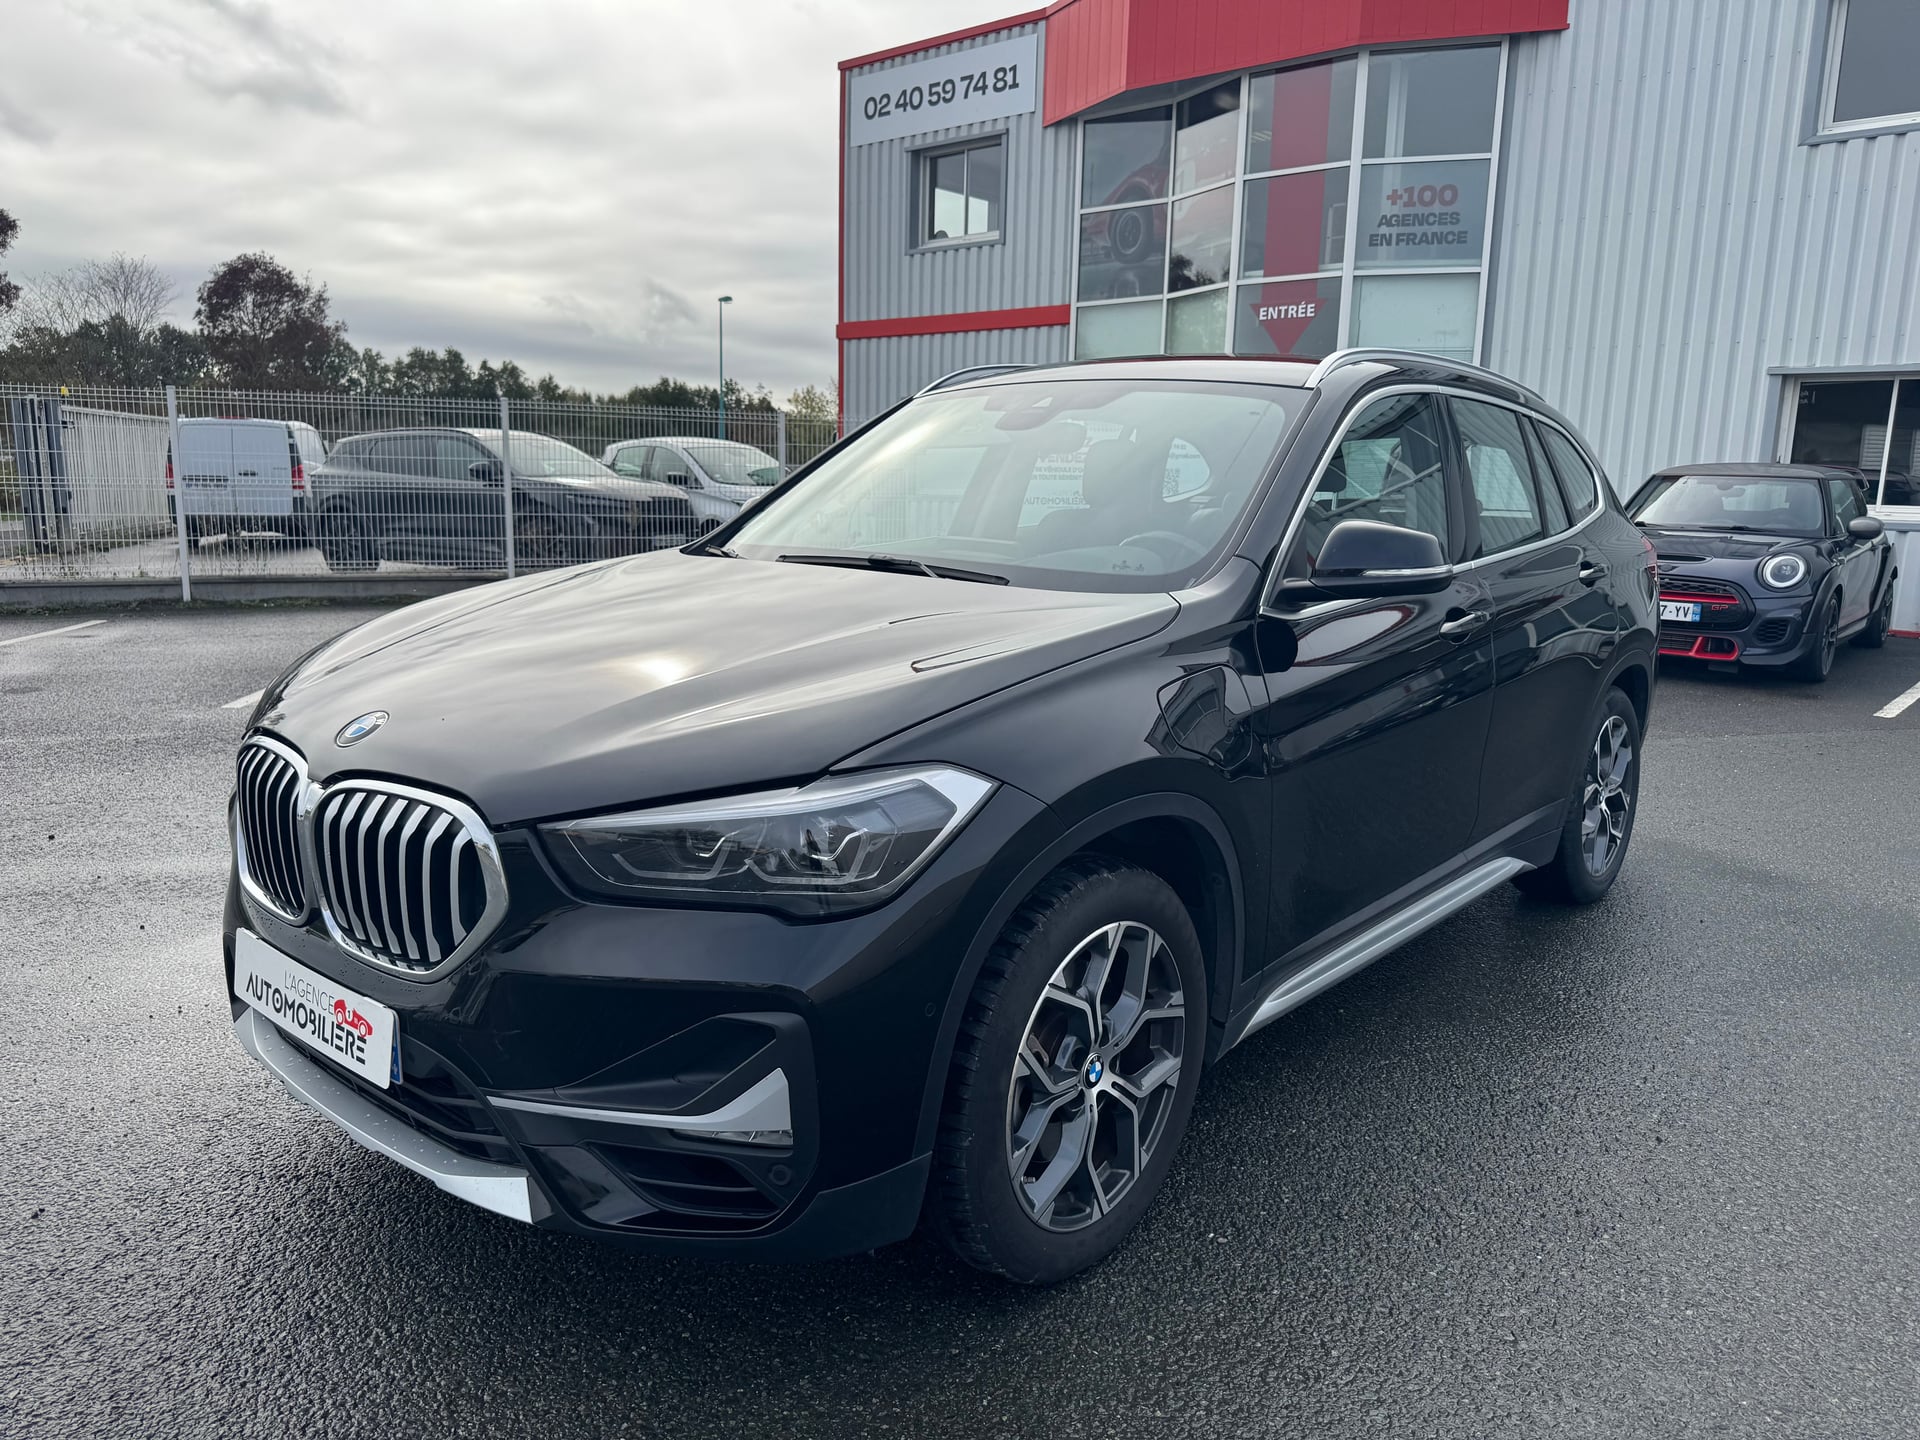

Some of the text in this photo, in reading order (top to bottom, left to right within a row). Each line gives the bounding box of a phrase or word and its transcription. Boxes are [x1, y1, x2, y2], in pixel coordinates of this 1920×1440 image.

[864, 64, 1020, 120] 02 40 59 74 81
[1386, 184, 1458, 208] +100
[1377, 212, 1461, 228] AGENCES
[1368, 230, 1469, 247] EN FRANCE
[1259, 301, 1315, 320] ENTRÉE
[285, 970, 335, 1015] L'AGENCE
